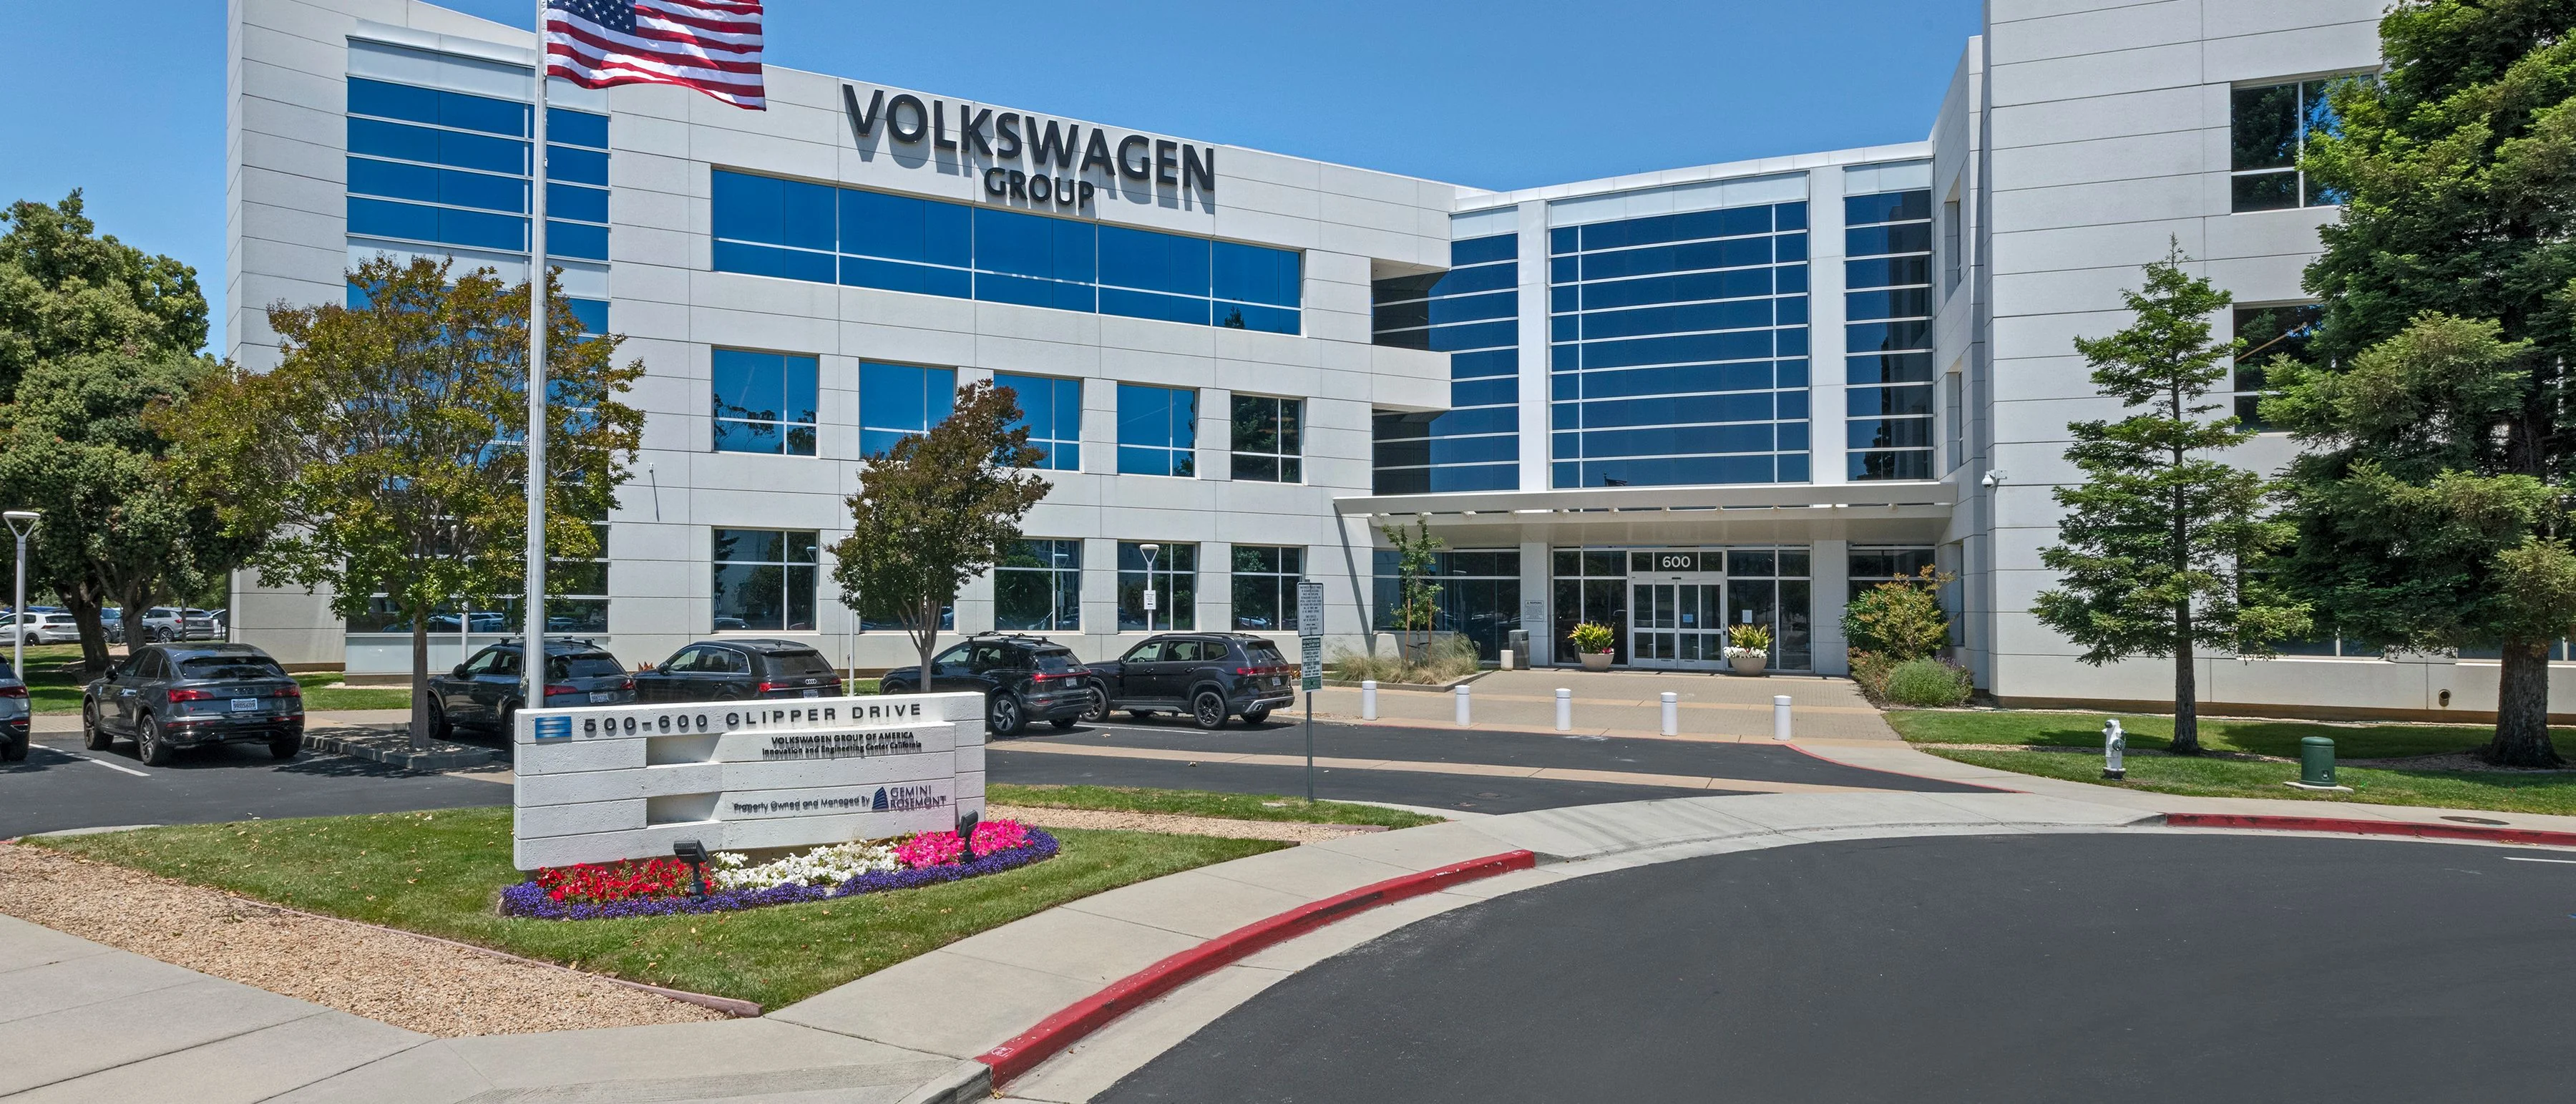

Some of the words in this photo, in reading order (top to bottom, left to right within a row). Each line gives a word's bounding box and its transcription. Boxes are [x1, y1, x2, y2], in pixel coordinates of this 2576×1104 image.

[843, 84, 1215, 192] VOLKSWAGEN
[984, 167, 1095, 208] GROUP
[1662, 556, 1691, 567] 600
[584, 714, 708, 732] 500-600
[726, 708, 836, 726] CLIPPER
[852, 704, 921, 720] DRIVE
[771, 736, 831, 744] VOLKSWAGEN
[762, 746, 803, 755] Innovation
[821, 743, 864, 754] Engineering
[889, 741, 922, 749] California
[890, 785, 931, 798] GEMINI
[733, 802, 769, 811] Property
[770, 800, 800, 809] Owned
[802, 798, 819, 807] and
[821, 796, 859, 806] Managed
[861, 796, 870, 806] By
[890, 795, 946, 809] ROSEMONT
